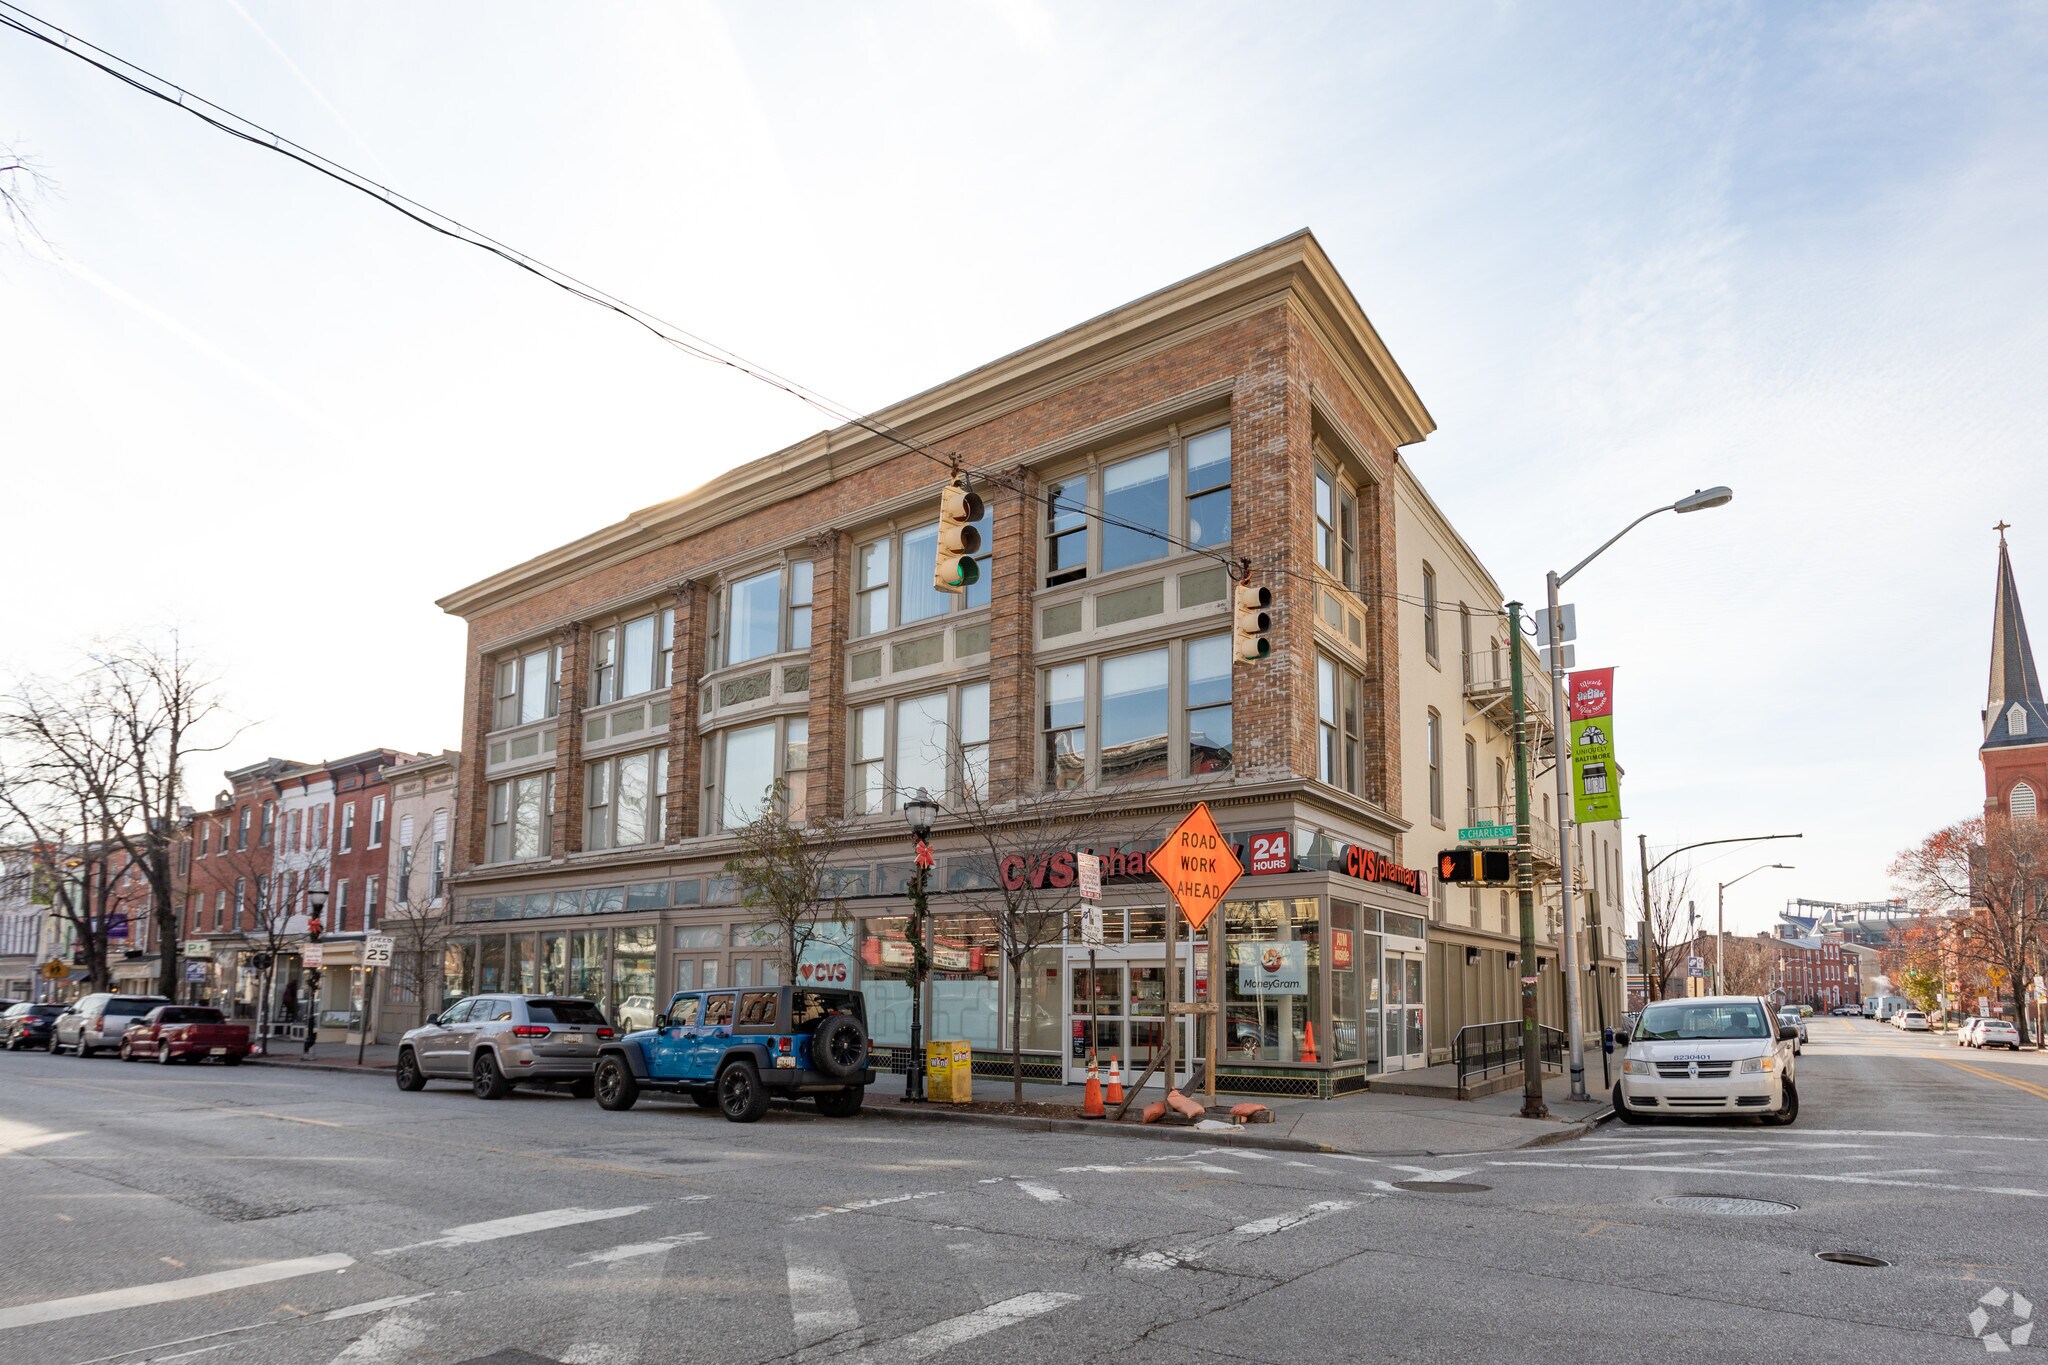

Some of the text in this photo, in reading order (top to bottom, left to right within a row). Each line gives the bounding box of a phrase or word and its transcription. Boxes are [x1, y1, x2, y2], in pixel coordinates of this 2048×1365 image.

[1575, 753, 1611, 763] BALTIMORE
[1576, 745, 1608, 756] UNIQUELY
[1181, 832, 1217, 850] ROAD
[1460, 830, 1466, 839] S
[1467, 828, 1504, 839] CHARLES
[1253, 837, 1286, 860] 24
[1181, 855, 1217, 873] WORK
[1253, 859, 1287, 871] HOURS
[1347, 844, 1417, 893] CVS/pharmacy
[1177, 881, 1220, 900] AHEAD
[1337, 932, 1348, 947] ATM
[367, 949, 389, 961] 25
[815, 963, 847, 982] CVS
[1243, 980, 1300, 990] MoneyGram
